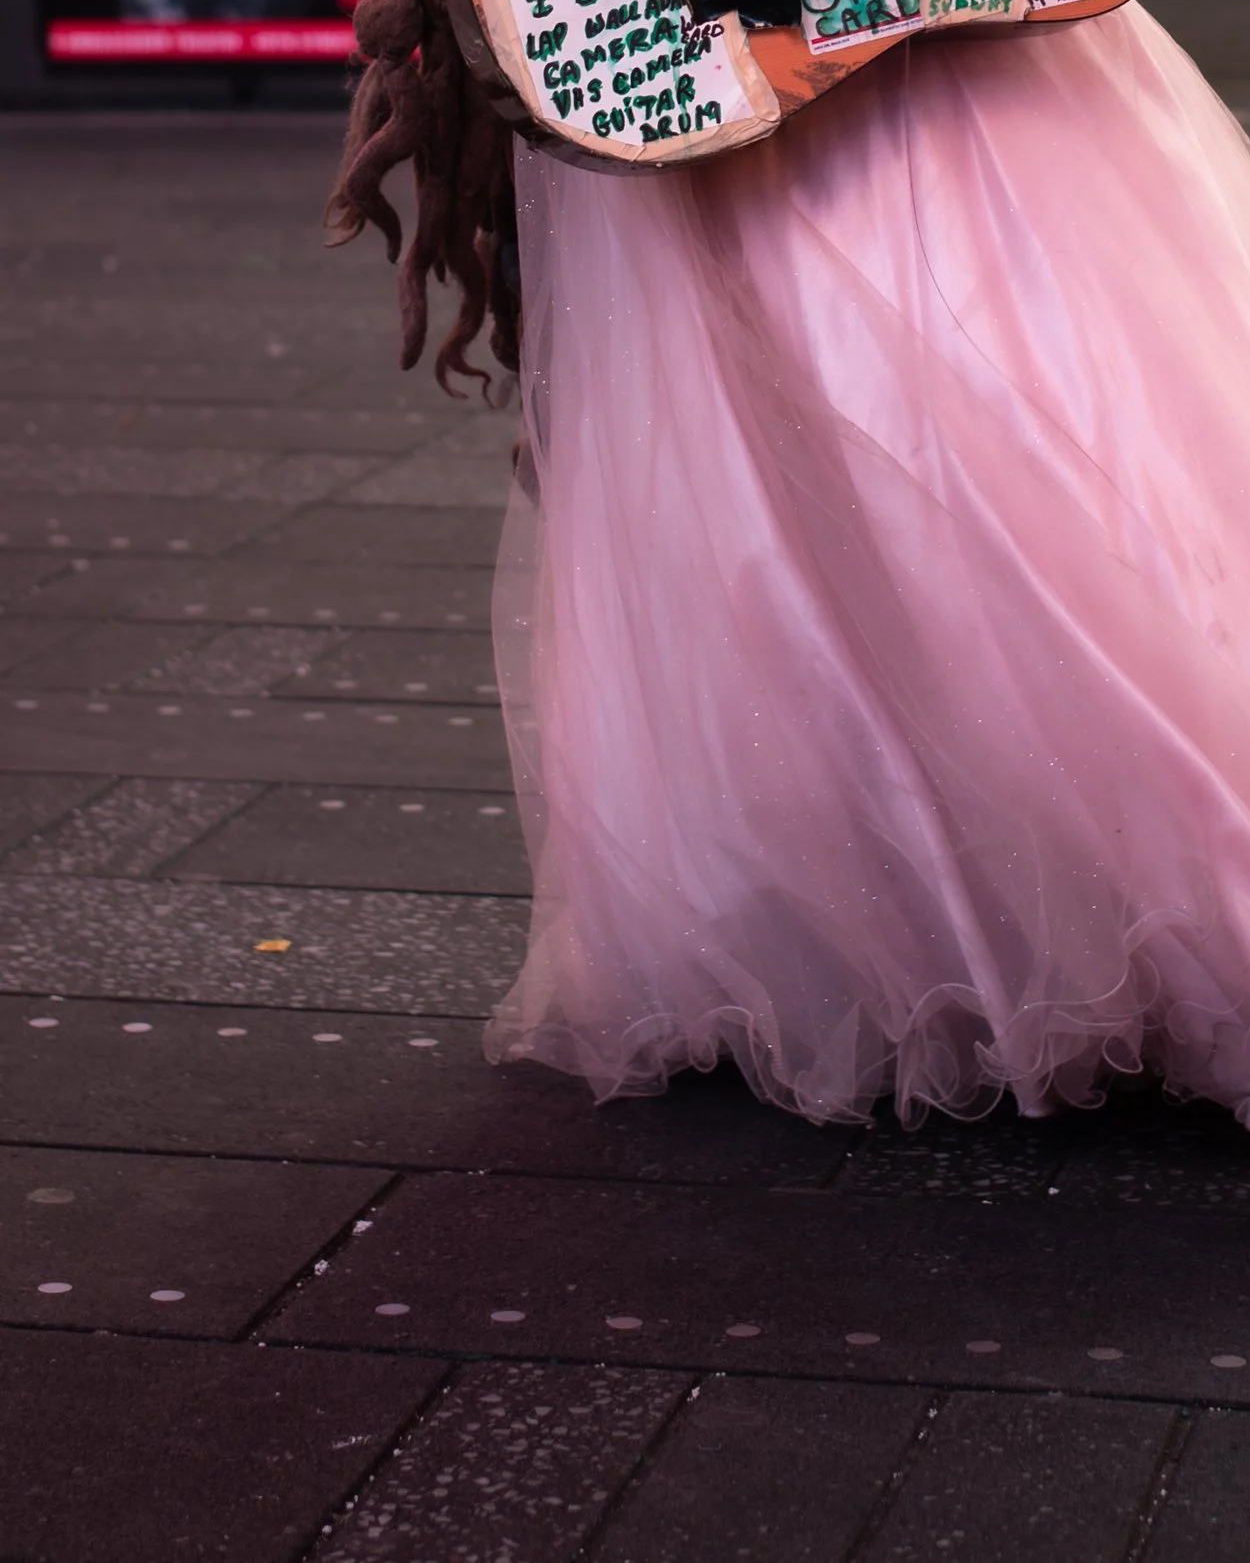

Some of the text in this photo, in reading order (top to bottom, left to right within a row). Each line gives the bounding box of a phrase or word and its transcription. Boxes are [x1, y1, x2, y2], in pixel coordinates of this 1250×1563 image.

[526, 22, 568, 61] LAP
[585, 0, 641, 39] WALL
[543, 17, 679, 89] CAMERA
[550, 38, 712, 119] VHS CAMERA
[640, 101, 722, 143] DRUM
